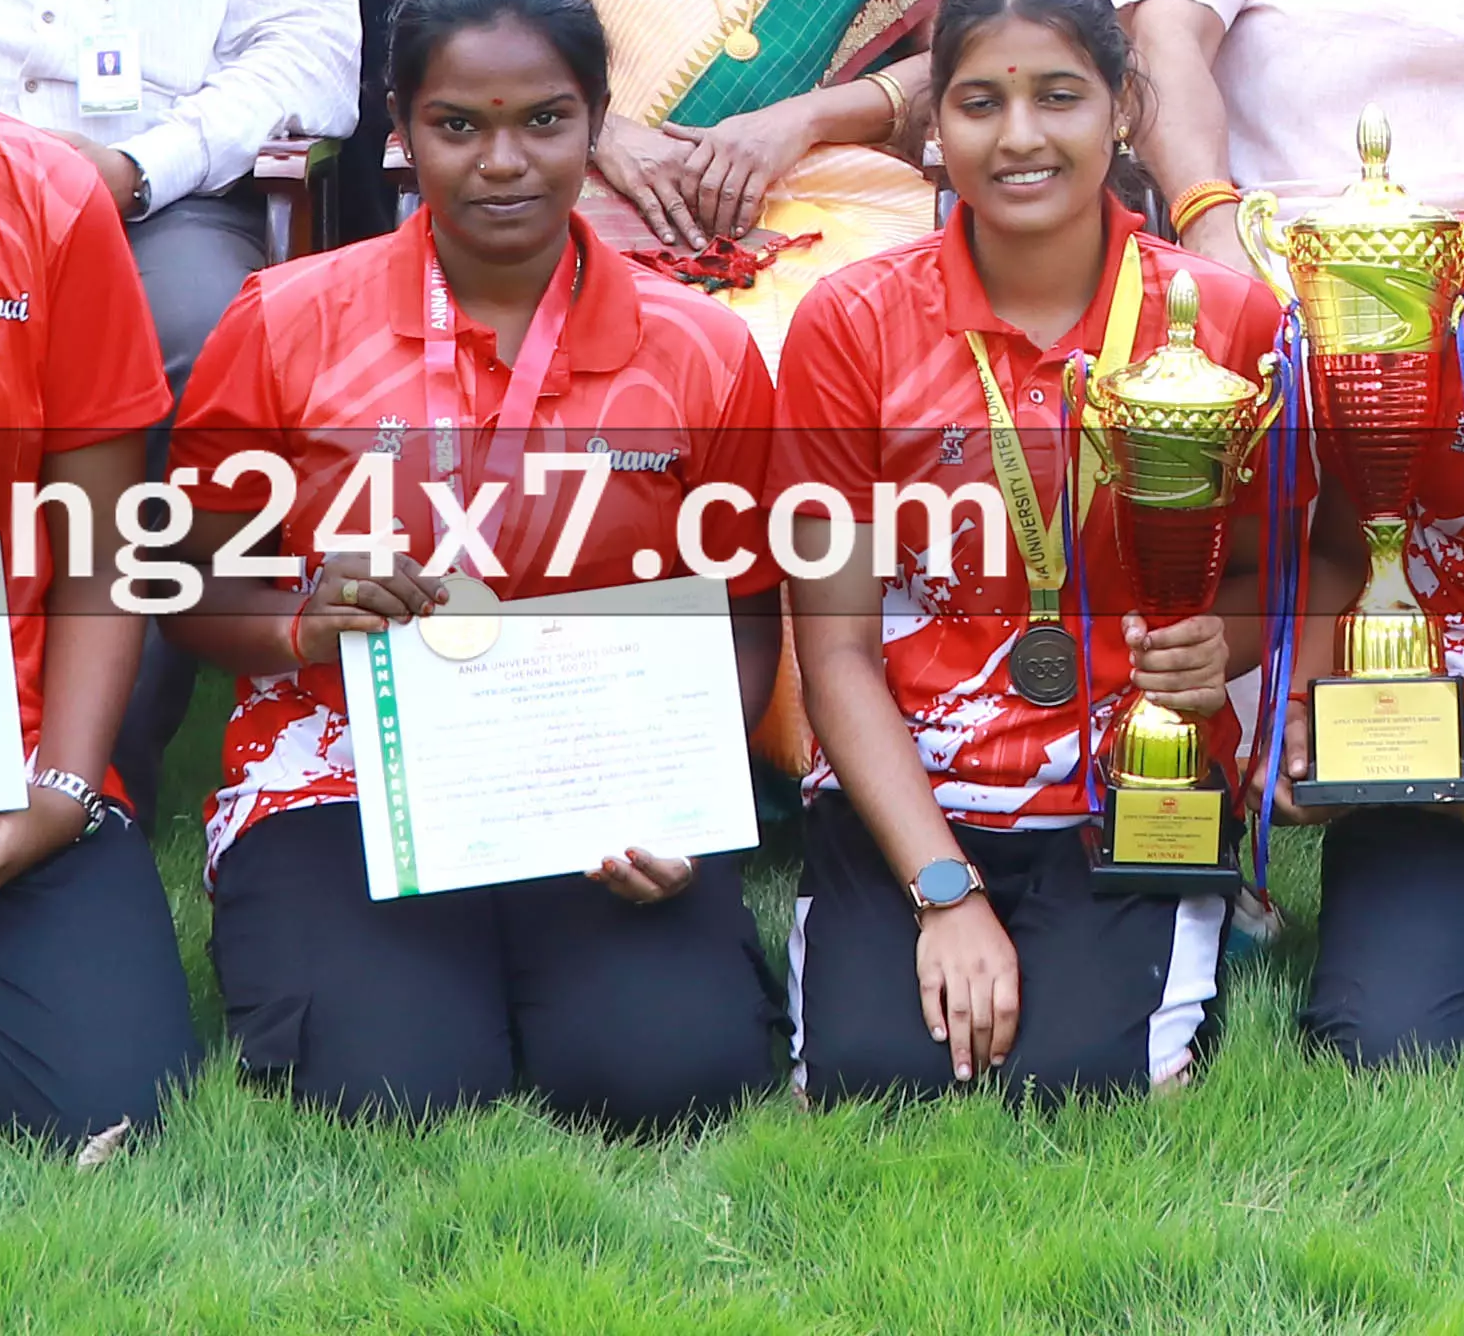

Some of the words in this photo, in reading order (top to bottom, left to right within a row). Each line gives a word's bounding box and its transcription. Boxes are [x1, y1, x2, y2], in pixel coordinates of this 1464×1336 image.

[430, 287, 448, 331] ANNA
[994, 428, 1020, 474] INTER
[1009, 475, 1047, 566] UNIVERSITY
[458, 664, 489, 675] ANNA
[491, 654, 552, 670] UNIVERSITY
[1365, 765, 1410, 775] WINNER
[1146, 851, 1185, 860] RUNNER
